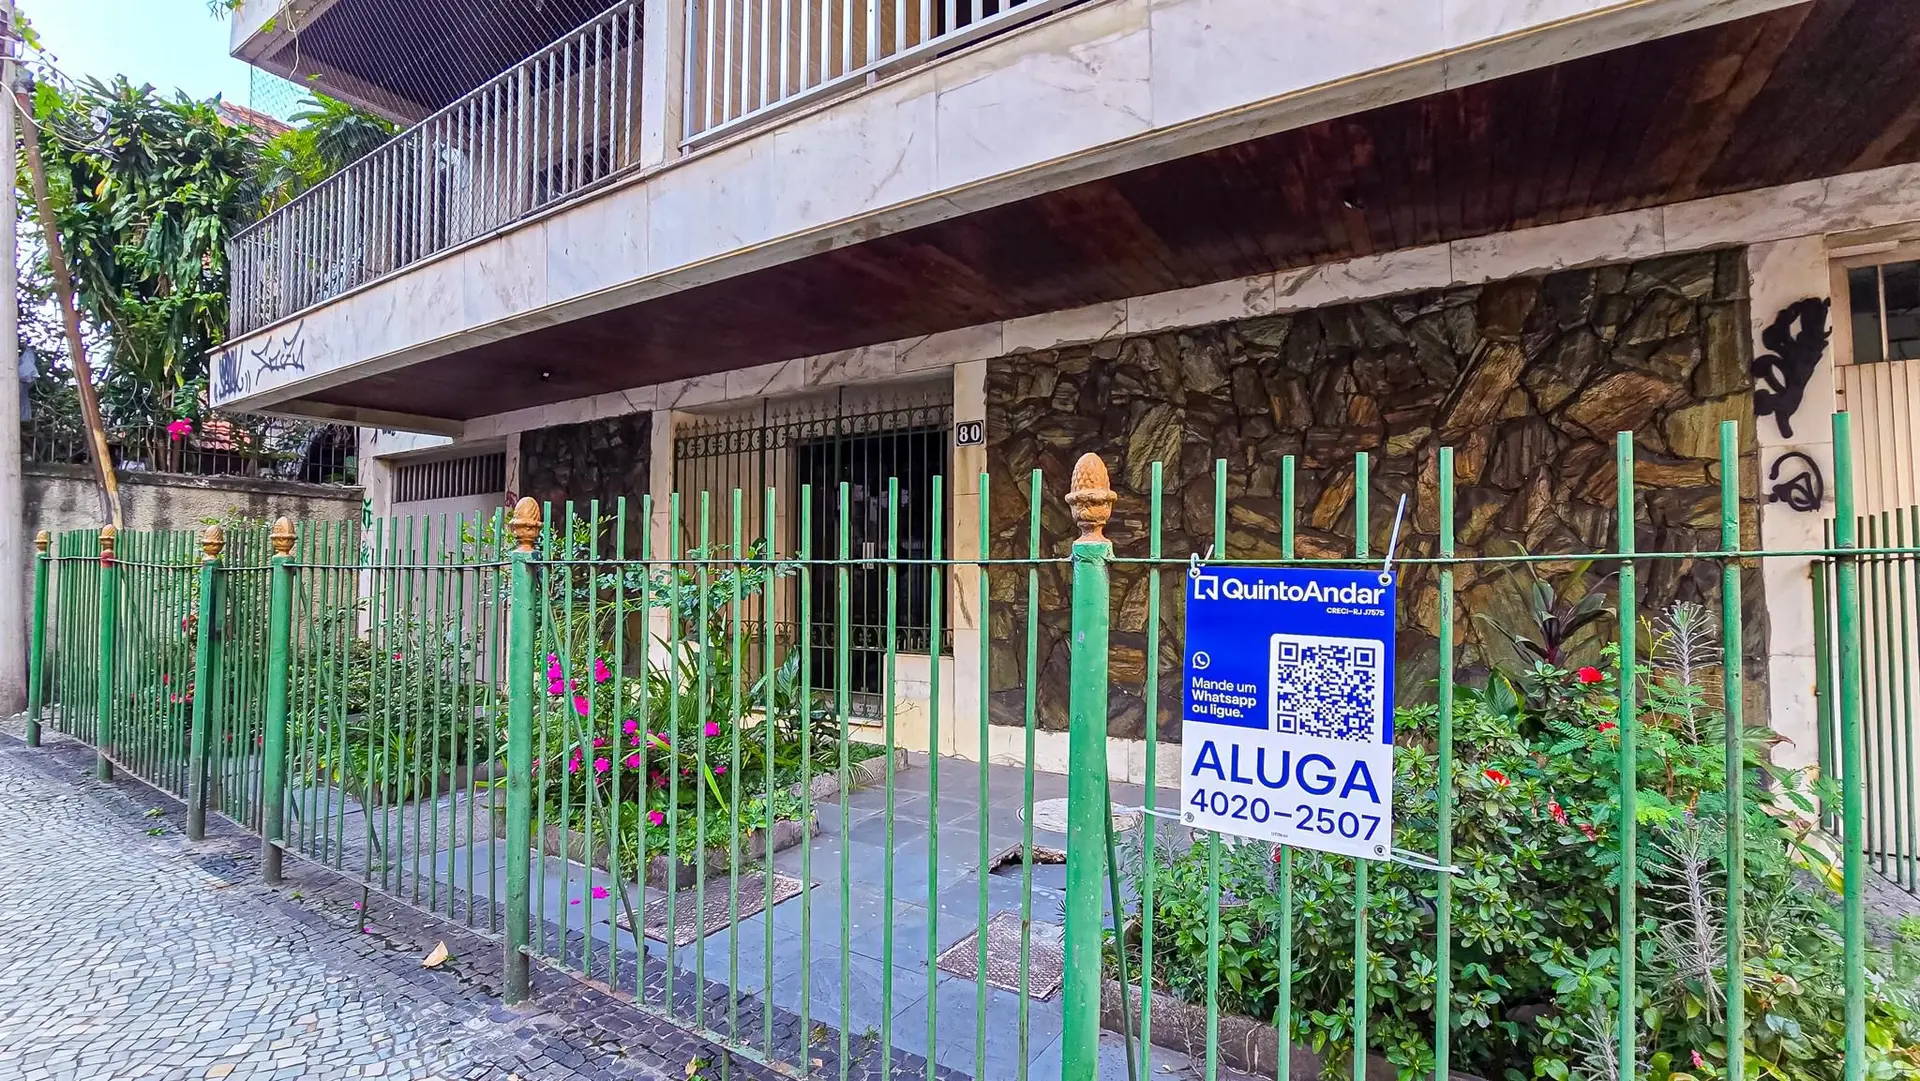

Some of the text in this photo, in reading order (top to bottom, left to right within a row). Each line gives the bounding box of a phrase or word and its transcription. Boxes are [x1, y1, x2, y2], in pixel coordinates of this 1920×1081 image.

[959, 424, 980, 442] 80
[1222, 577, 1386, 605] QuintoAndar
[1326, 607, 1363, 616] CRECI-RJ
[1192, 676, 1257, 694] Mande um
[1191, 689, 1257, 708] Whatsapp
[1191, 703, 1244, 718] ou ligue.
[1191, 740, 1382, 804] ALUGA
[1190, 788, 1382, 842] 4020-2507
